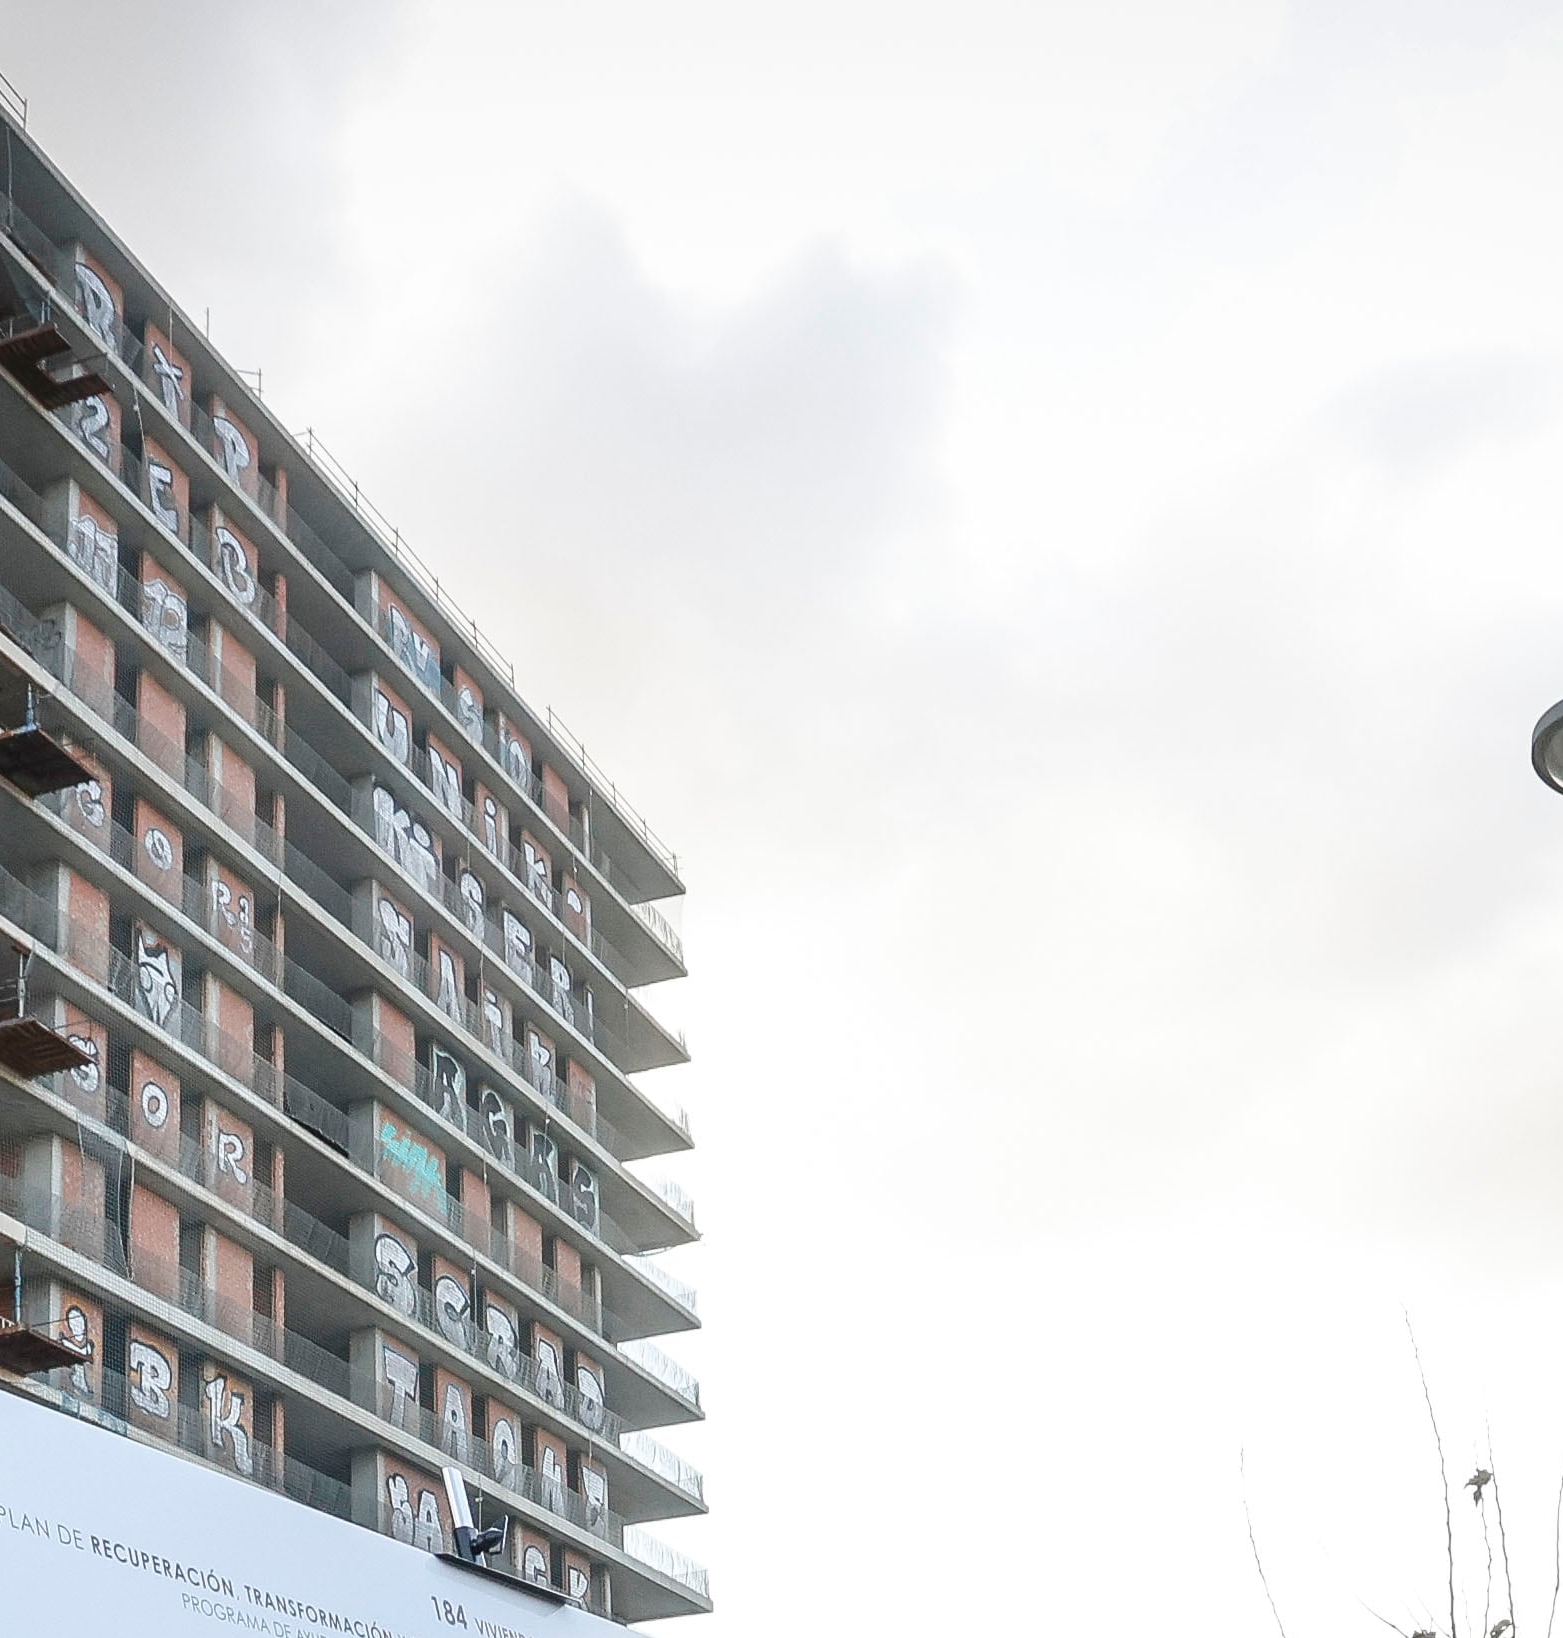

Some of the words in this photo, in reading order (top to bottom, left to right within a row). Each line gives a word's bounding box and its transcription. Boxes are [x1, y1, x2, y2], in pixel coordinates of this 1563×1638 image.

[57, 1524, 84, 1550] DE
[90, 1535, 239, 1600] RECUPERACIÓN,
[182, 1592, 271, 1635] PROGRAMA
[431, 1596, 468, 1630] 184
